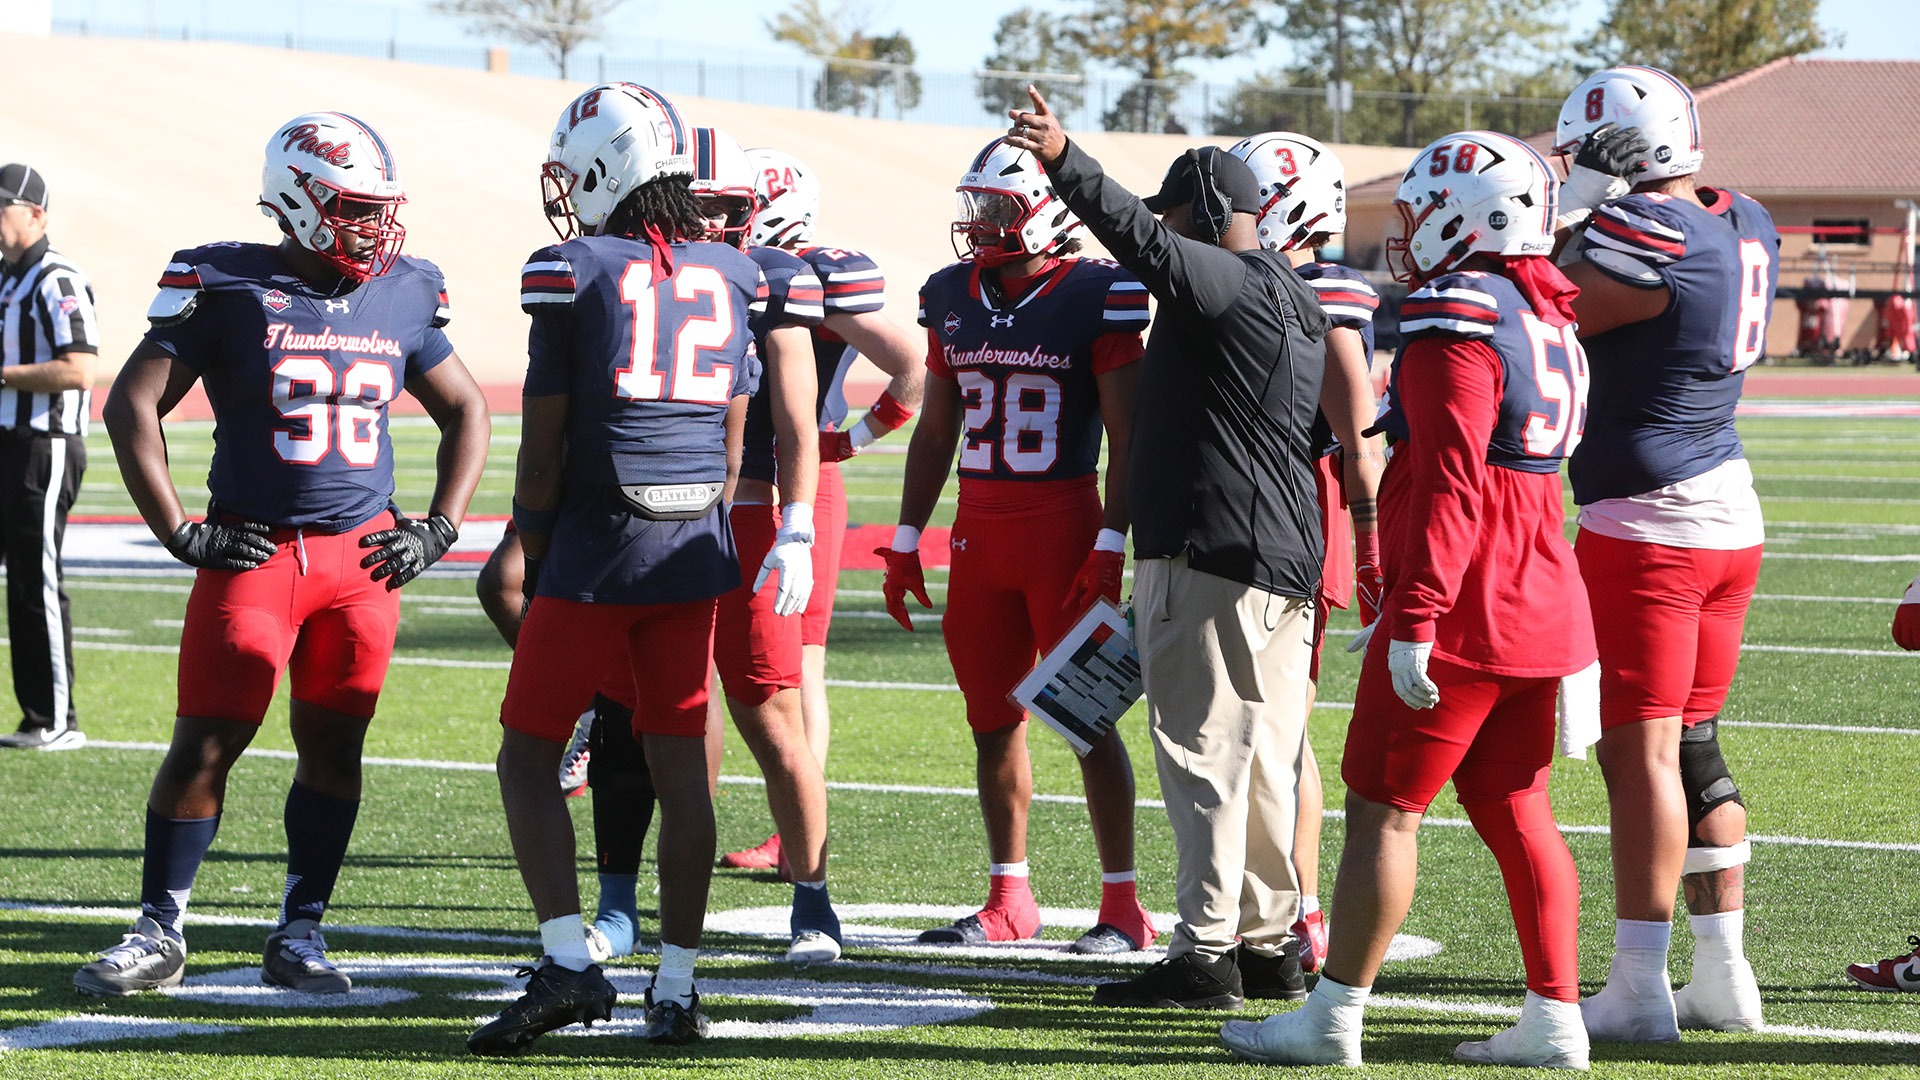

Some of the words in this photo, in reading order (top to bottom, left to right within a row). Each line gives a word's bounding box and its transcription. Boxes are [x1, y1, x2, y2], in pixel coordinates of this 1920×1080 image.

[568, 91, 601, 129] 12
[1585, 87, 1604, 122] 8
[284, 124, 350, 165] Pack
[1275, 147, 1298, 177] 3
[1430, 143, 1479, 177] 58
[765, 167, 797, 195] 24
[265, 295, 290, 306] RMAC
[1730, 237, 1770, 374] 8
[263, 322, 402, 358] Thunderwolves
[613, 259, 734, 405] 12
[943, 341, 1072, 370] Thunderwolves
[1518, 309, 1590, 458] 58
[270, 354, 395, 468] 98
[955, 368, 1063, 475] 28
[650, 488, 705, 502] BATTLE
